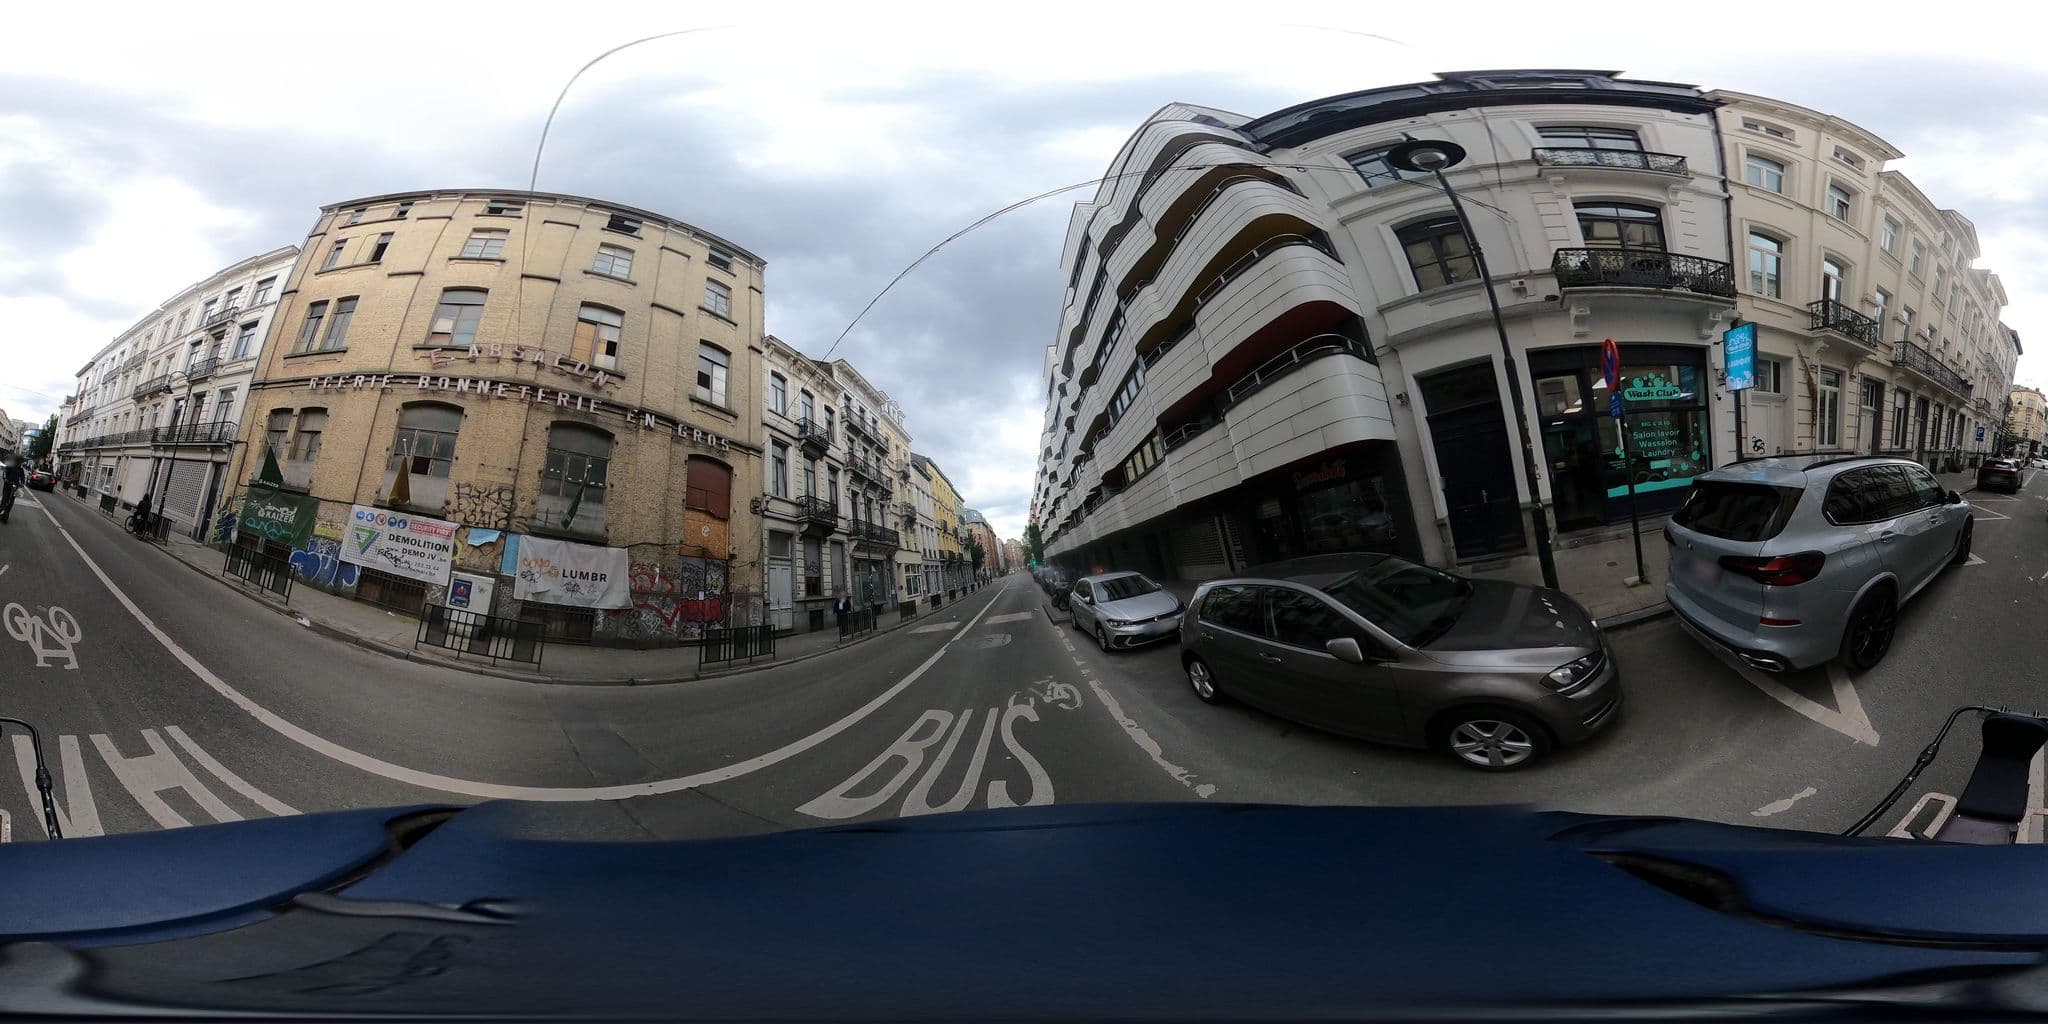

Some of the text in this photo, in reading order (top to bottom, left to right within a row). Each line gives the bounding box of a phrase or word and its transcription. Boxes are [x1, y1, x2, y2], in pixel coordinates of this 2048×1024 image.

[467, 343, 609, 387] ABSALON
[1628, 390, 1654, 398] Wash
[417, 375, 602, 414] BONNETERIE
[627, 409, 656, 429] EN
[677, 423, 730, 452] GROS
[1633, 429, 1680, 440] Salon lavoir
[1639, 438, 1678, 448] Wassalon
[1642, 448, 1676, 458] Laundry
[388, 533, 450, 553] DEMOLITION
[401, 547, 426, 558] DEMO
[562, 569, 607, 582] LUMBR
[794, 704, 1055, 819] BUS
